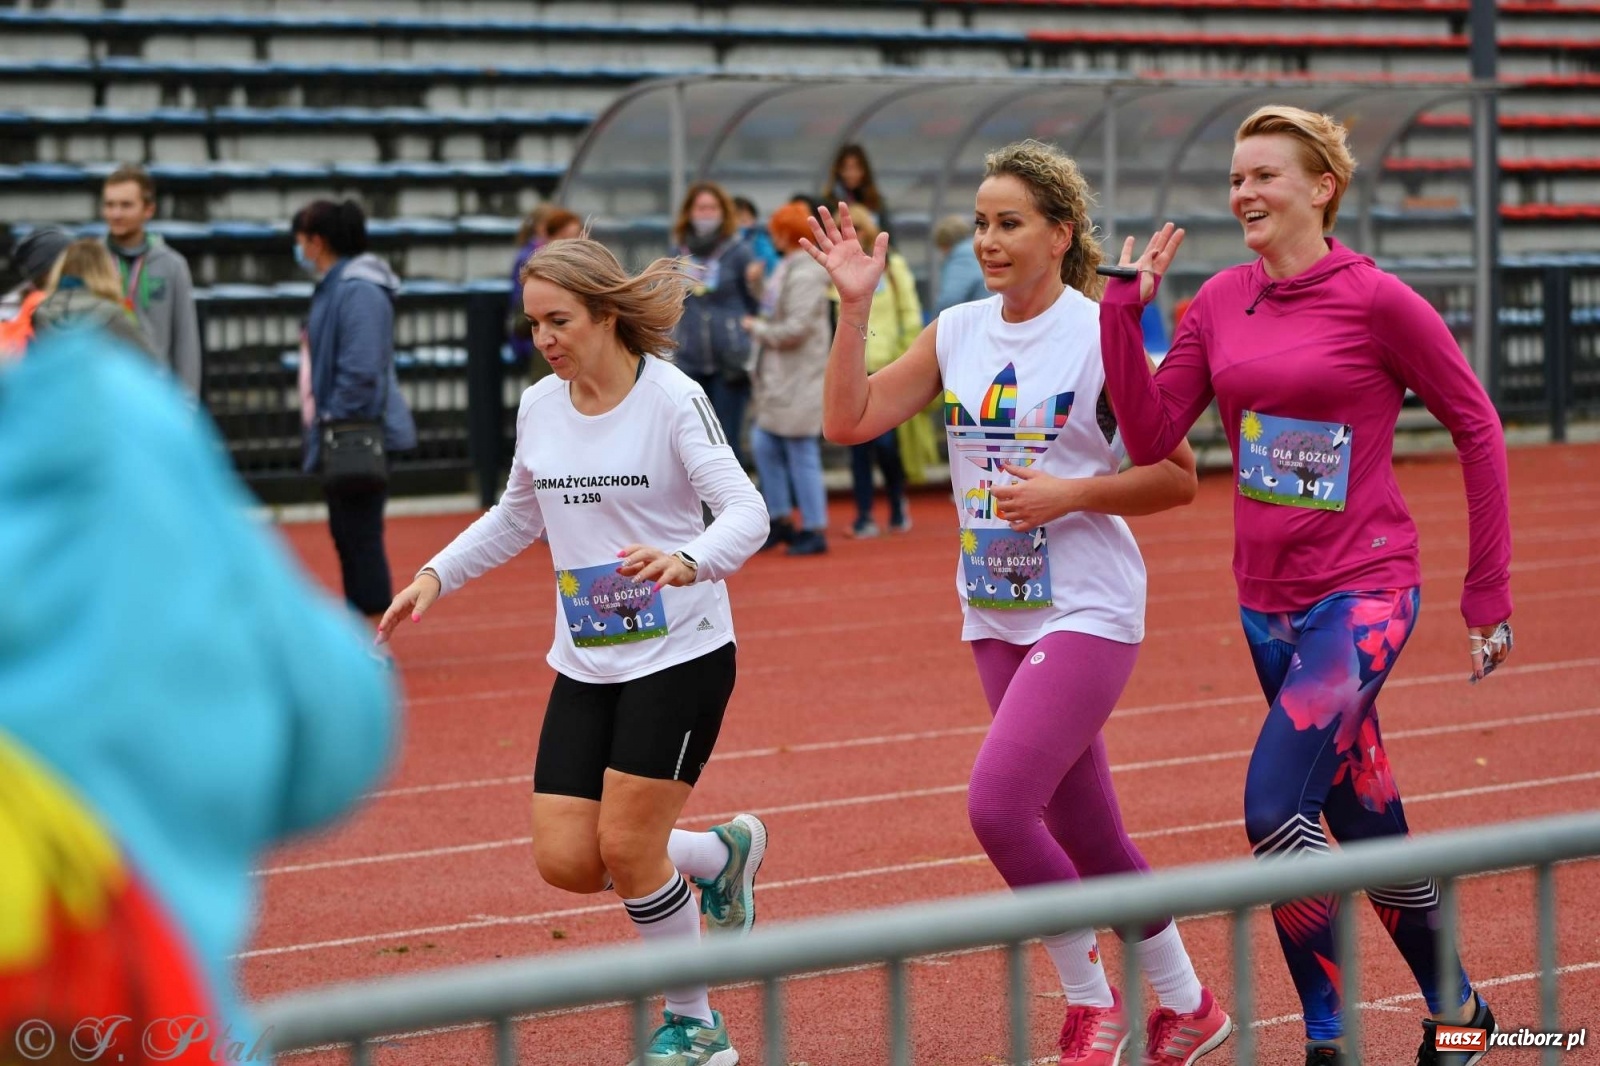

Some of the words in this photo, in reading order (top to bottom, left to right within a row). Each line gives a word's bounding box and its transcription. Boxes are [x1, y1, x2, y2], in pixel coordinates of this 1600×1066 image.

[1250, 443, 1268, 457] BIEG
[1272, 448, 1292, 460] DLA
[563, 494, 570, 504] 1
[573, 495, 580, 503] z
[582, 492, 602, 503] 250
[1296, 479, 1335, 500] 147
[971, 555, 985, 566] BIEG
[987, 556, 1002, 566] DLA
[572, 596, 590, 607] BIEG
[593, 594, 609, 605] DLA
[1010, 583, 1043, 601] 093
[622, 612, 656, 630] 012
